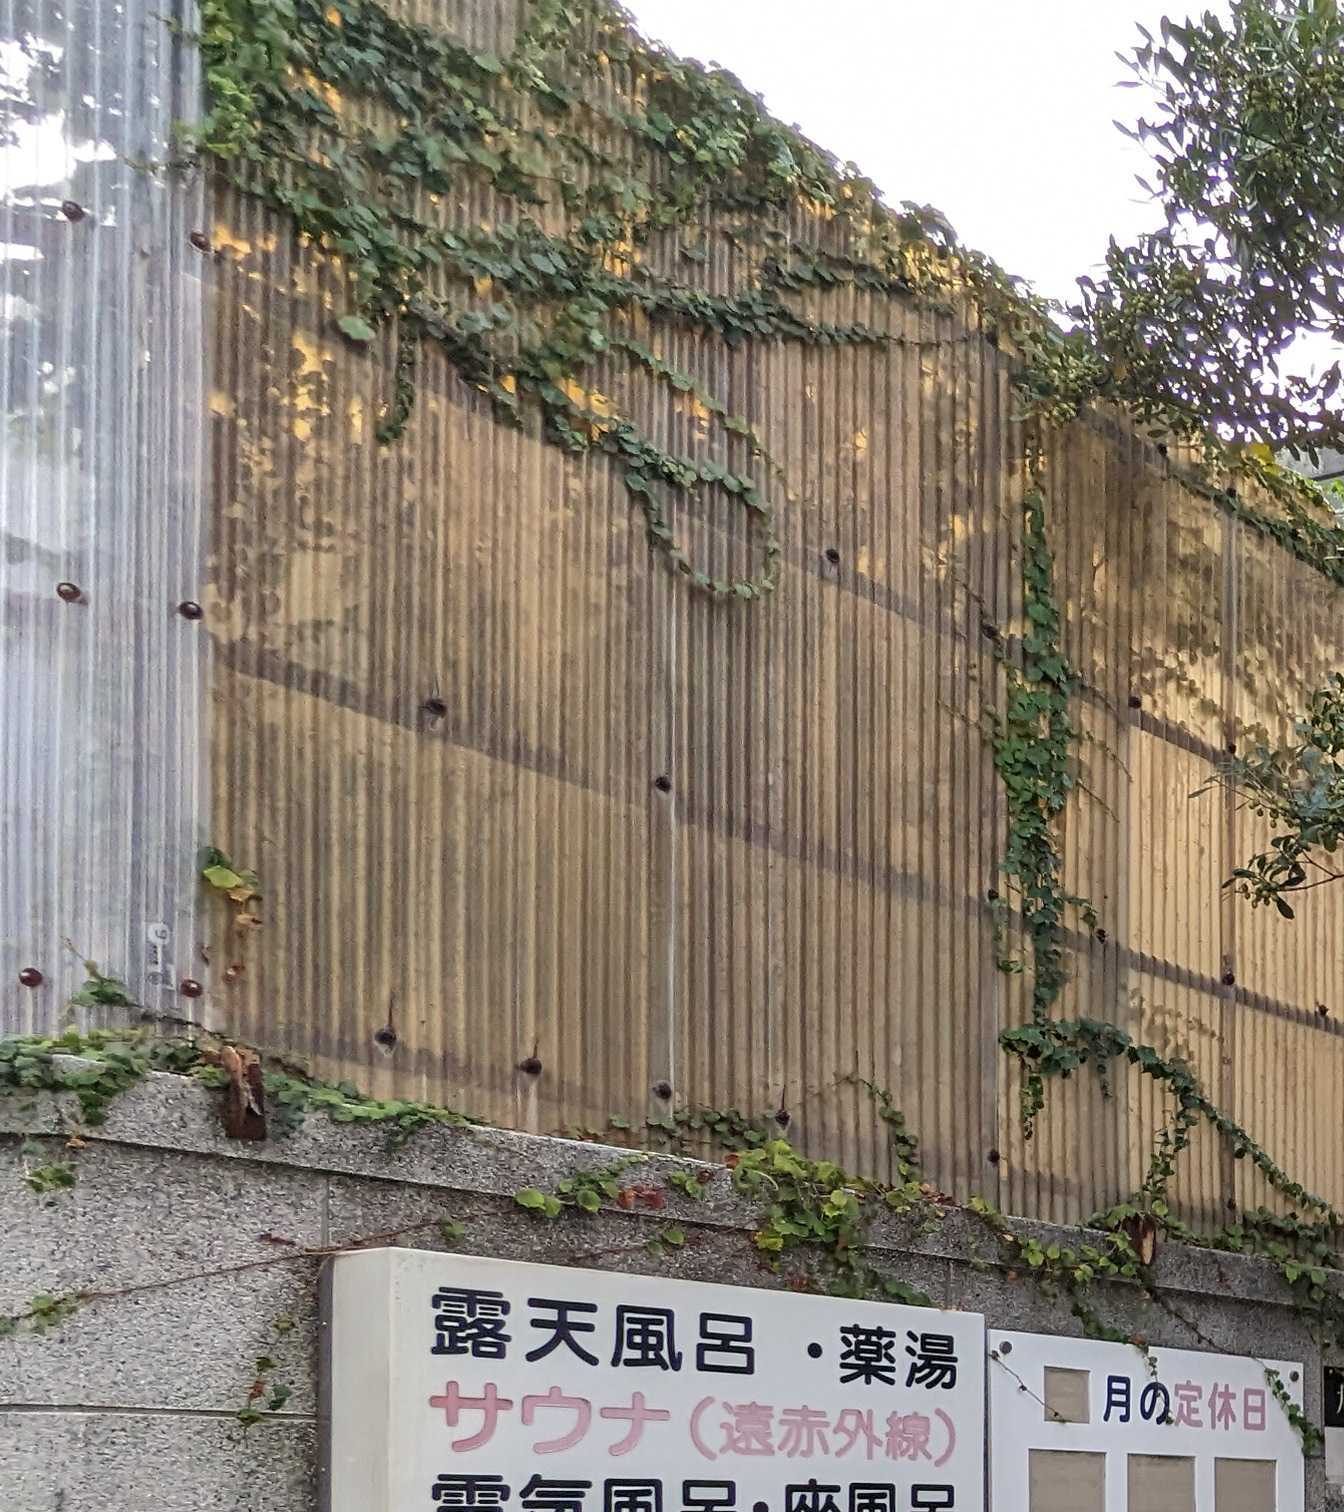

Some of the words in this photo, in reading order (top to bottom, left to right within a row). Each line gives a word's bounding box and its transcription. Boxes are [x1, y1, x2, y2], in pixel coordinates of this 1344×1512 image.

[430, 1286, 755, 1375] 露天風呂
[1103, 1374, 1266, 1432] 月の定休日
